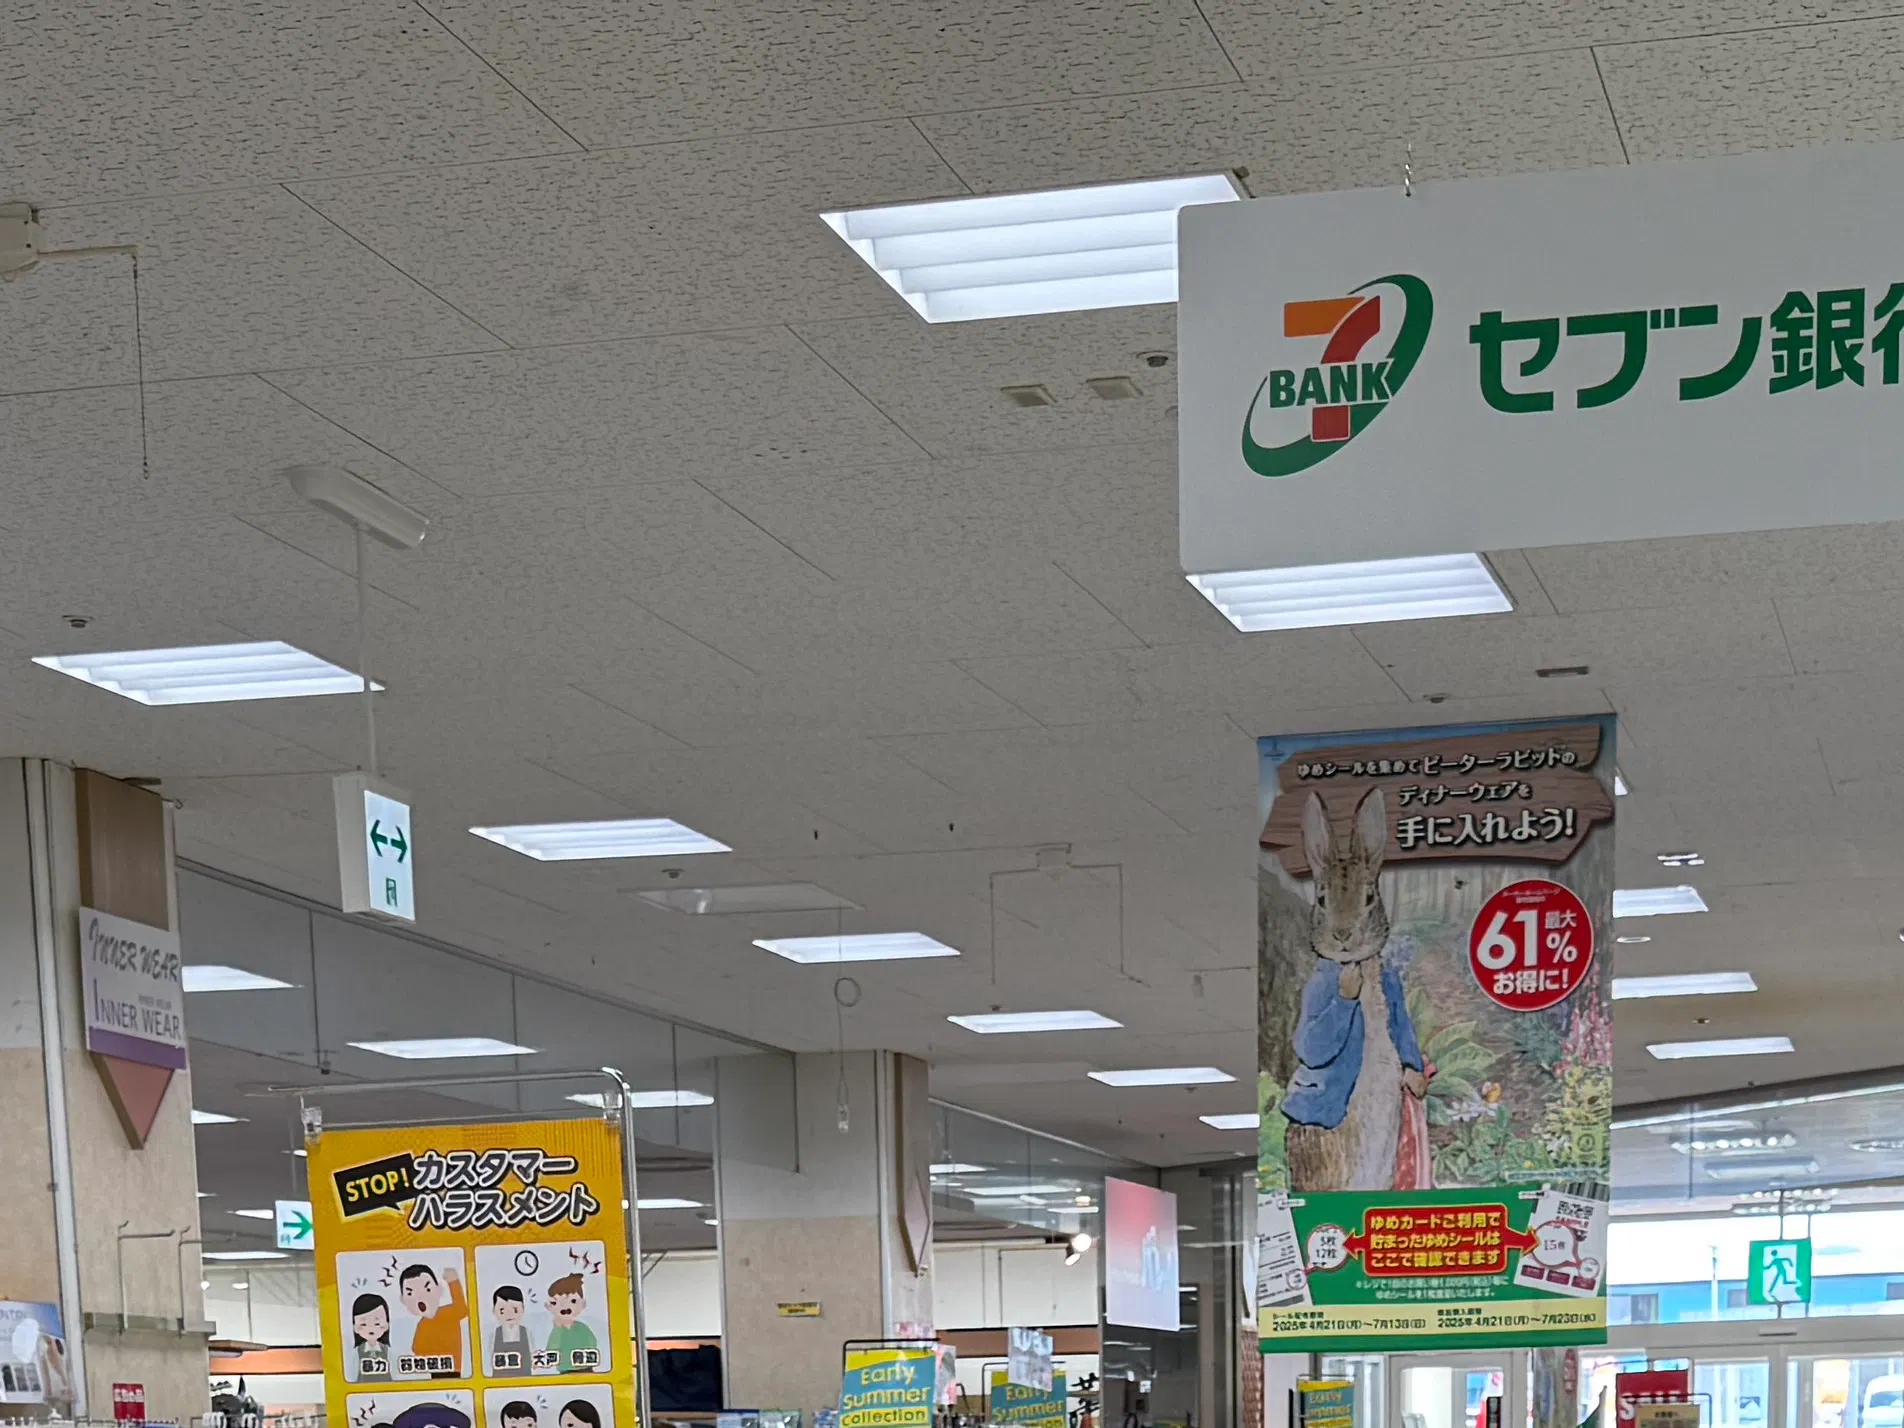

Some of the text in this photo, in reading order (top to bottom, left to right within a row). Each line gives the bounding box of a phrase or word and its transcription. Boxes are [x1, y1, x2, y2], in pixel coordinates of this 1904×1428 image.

[1268, 362, 1396, 410] BANK
[1297, 746, 1576, 780] ゆめシールを集めてピーターラビットの
[1399, 779, 1533, 807] ディナーウェアを
[1396, 807, 1575, 849] 手に入れよう!
[1493, 968, 1569, 995] お得に!
[93, 979, 181, 1042] INNER WEAR
[346, 1166, 410, 1202] STOP!
[413, 1150, 576, 1190] カスタマー
[408, 1183, 597, 1229] ハラスメント
[1370, 1212, 1501, 1230] ゆめカードご利用で
[1370, 1232, 1501, 1251] 貯まったゆめシールは
[860, 1364, 915, 1386] Early
[843, 1385, 931, 1411] Summer
[840, 1408, 926, 1428] Collection
